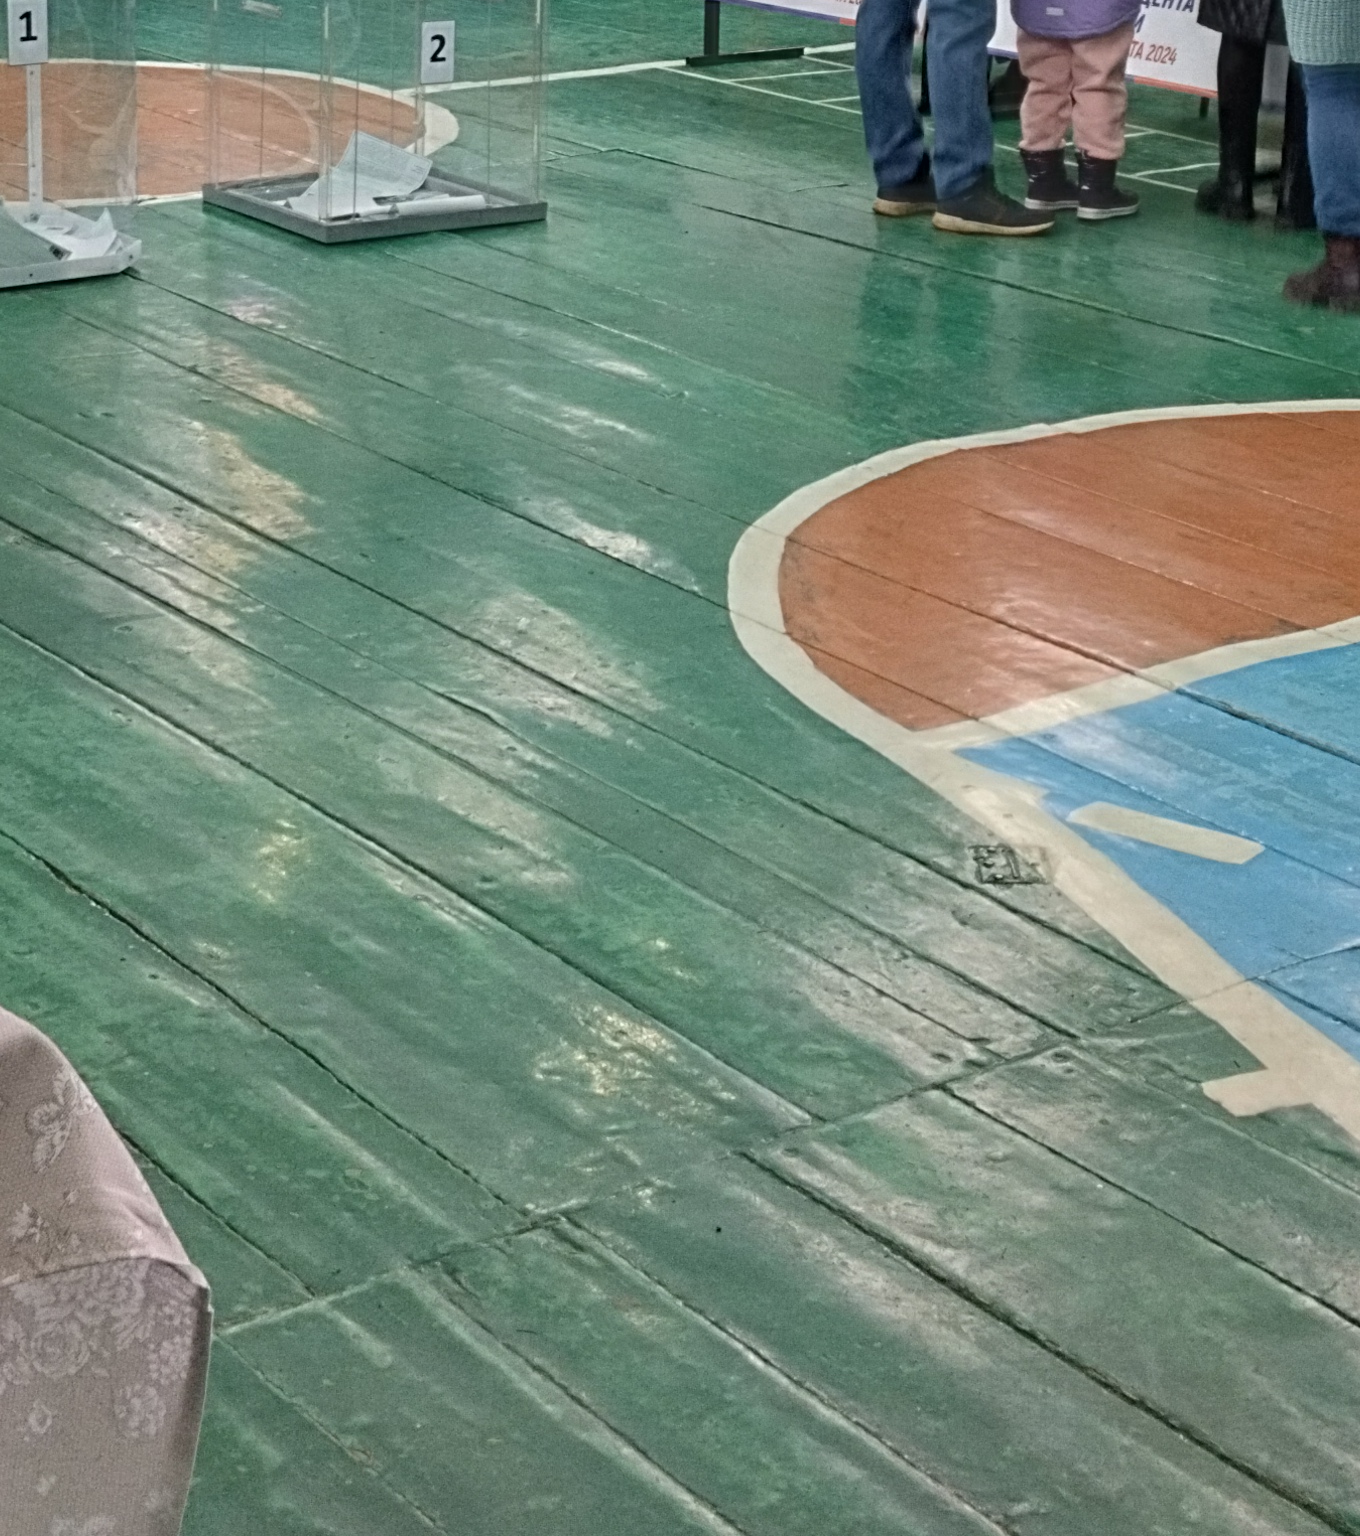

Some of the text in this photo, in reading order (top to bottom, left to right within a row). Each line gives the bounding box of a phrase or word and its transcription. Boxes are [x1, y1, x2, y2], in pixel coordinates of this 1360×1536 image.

[19, 11, 38, 42] 1
[430, 34, 447, 63] 2
[1145, 44, 1177, 66] 2024
